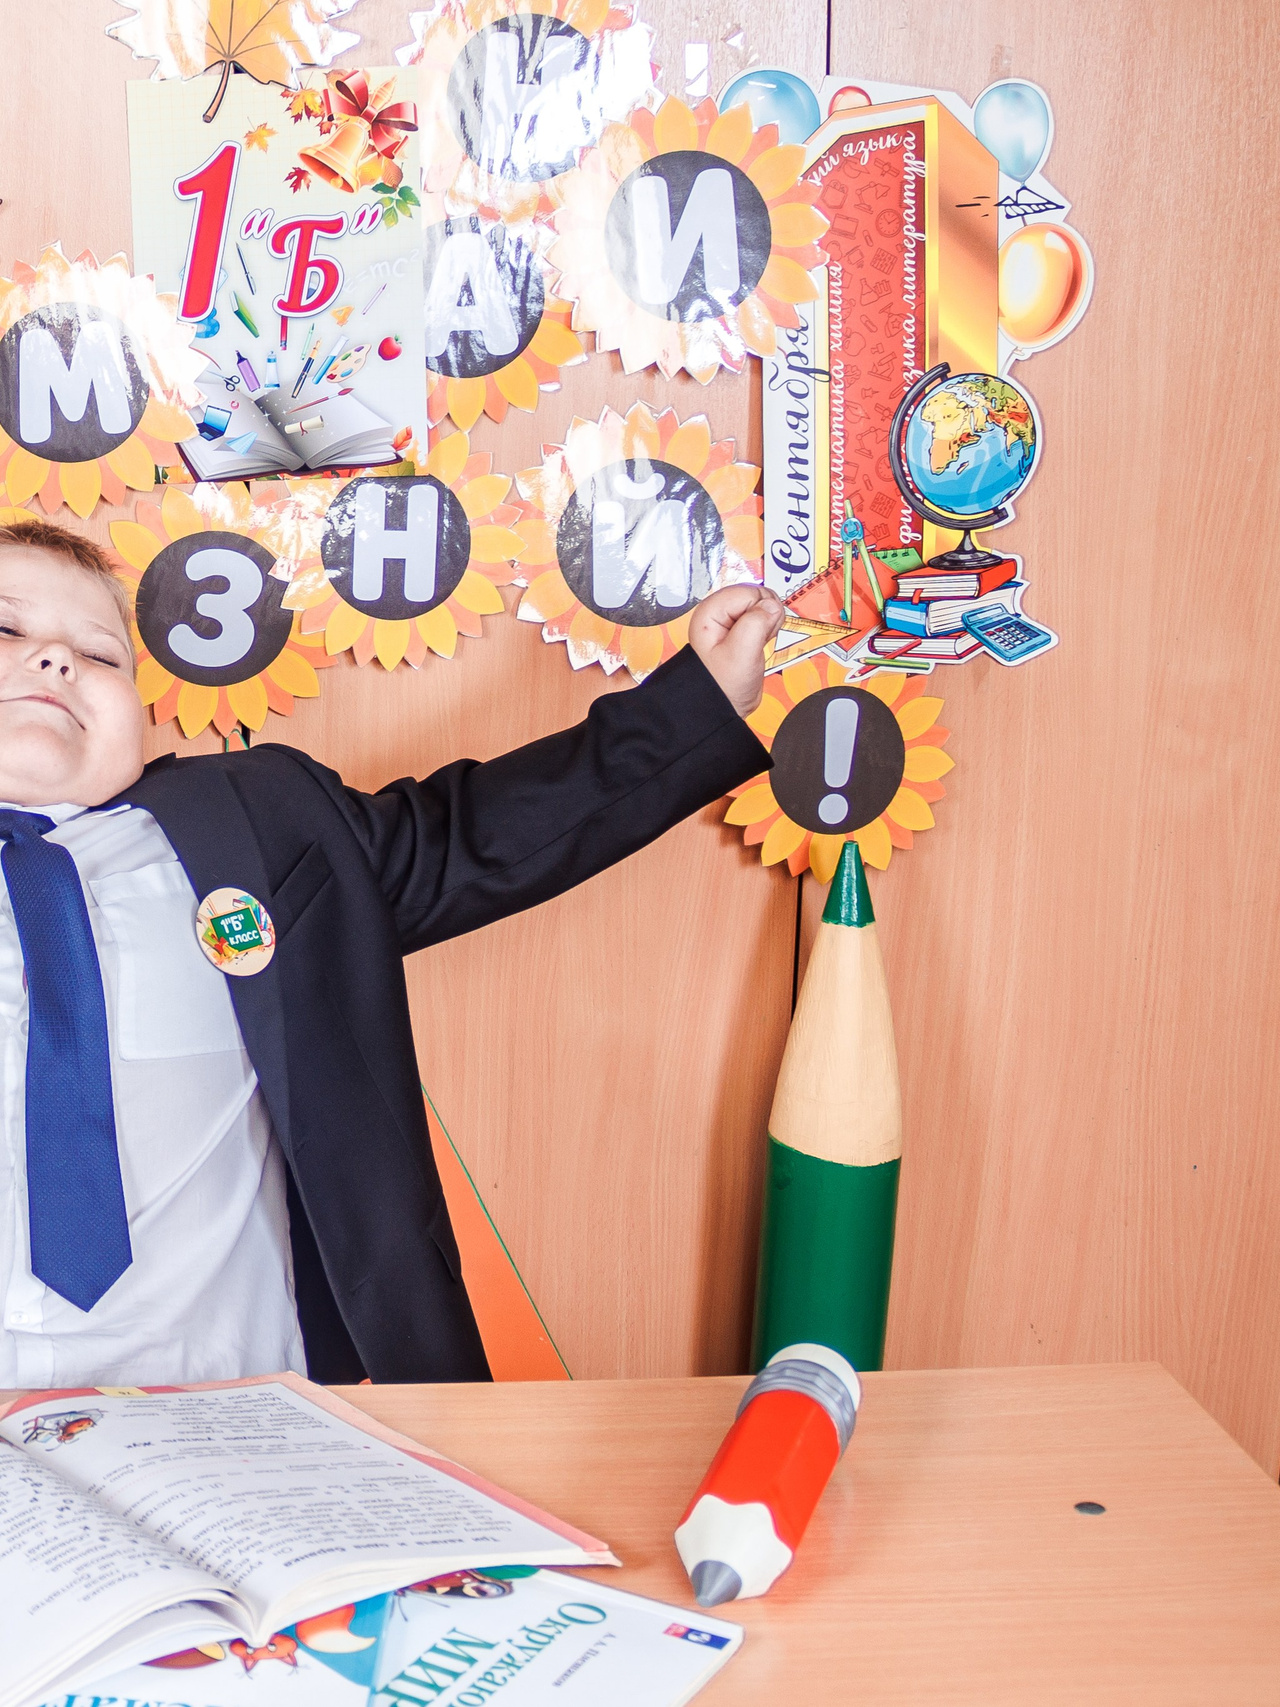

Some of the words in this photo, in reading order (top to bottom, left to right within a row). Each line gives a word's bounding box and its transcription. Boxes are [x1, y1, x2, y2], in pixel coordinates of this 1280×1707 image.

[842, 132, 903, 166] язык
[174, 140, 242, 321] 1
[632, 168, 740, 305] И
[901, 130, 926, 310] литература
[827, 261, 844, 351] химия
[18, 320, 132, 444] М
[768, 314, 832, 583] Сентября
[829, 359, 846, 556] математика
[351, 483, 439, 603] Н
[589, 472, 690, 609] Й
[817, 697, 860, 826] !
[229, 930, 260, 946] класс
[160, 1435, 216, 1443] учитель
[28, 1573, 91, 1615] болтайте!
[282, 1545, 346, 1567] баранка
[414, 1538, 464, 1546] калача
[448, 1602, 607, 1707] Окружаю
